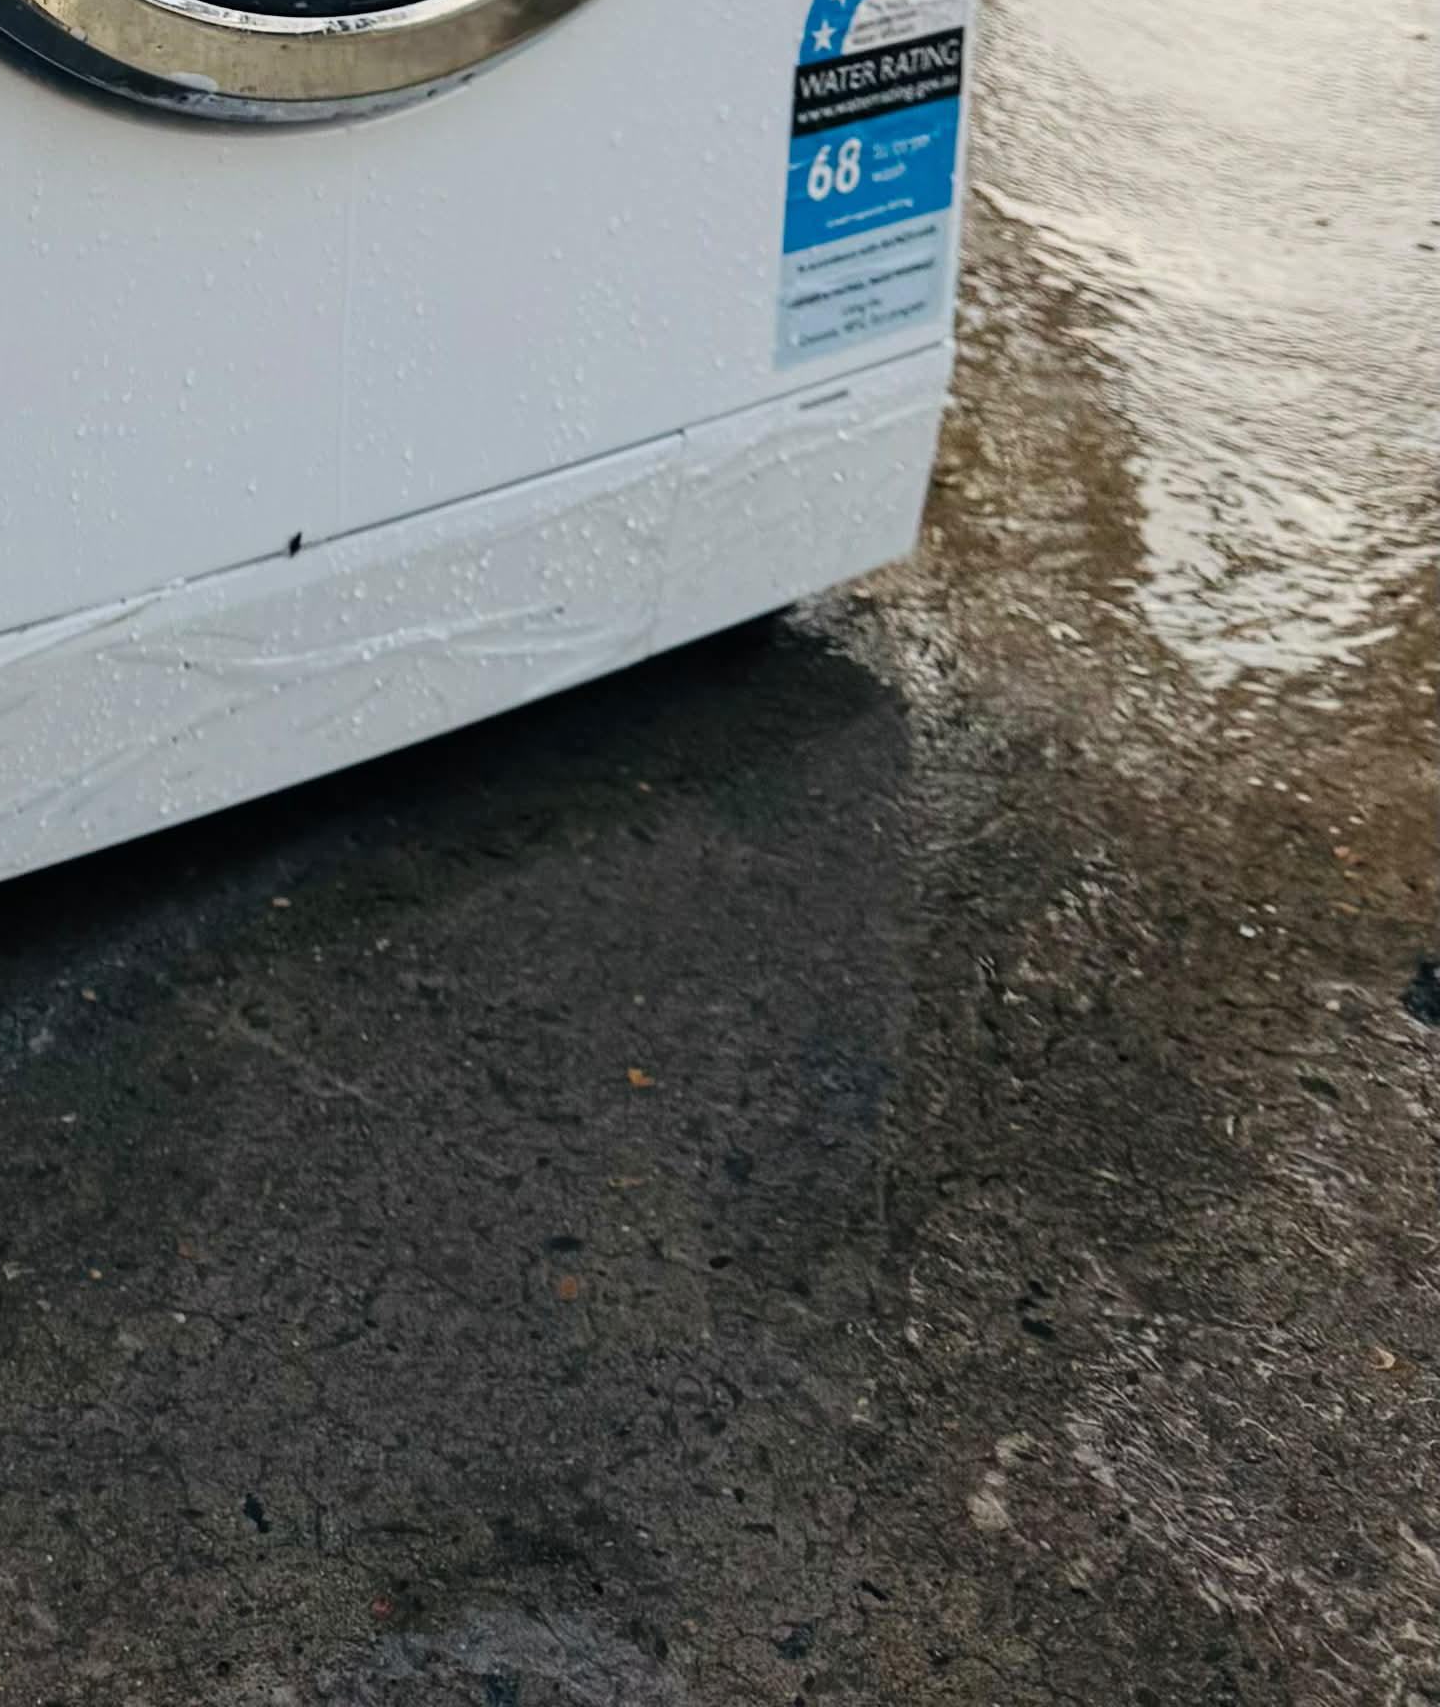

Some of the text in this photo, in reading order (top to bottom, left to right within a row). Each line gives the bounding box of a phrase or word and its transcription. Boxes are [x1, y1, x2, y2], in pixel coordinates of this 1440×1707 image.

[799, 38, 960, 98] WATER RATING
[807, 136, 863, 202] 68
